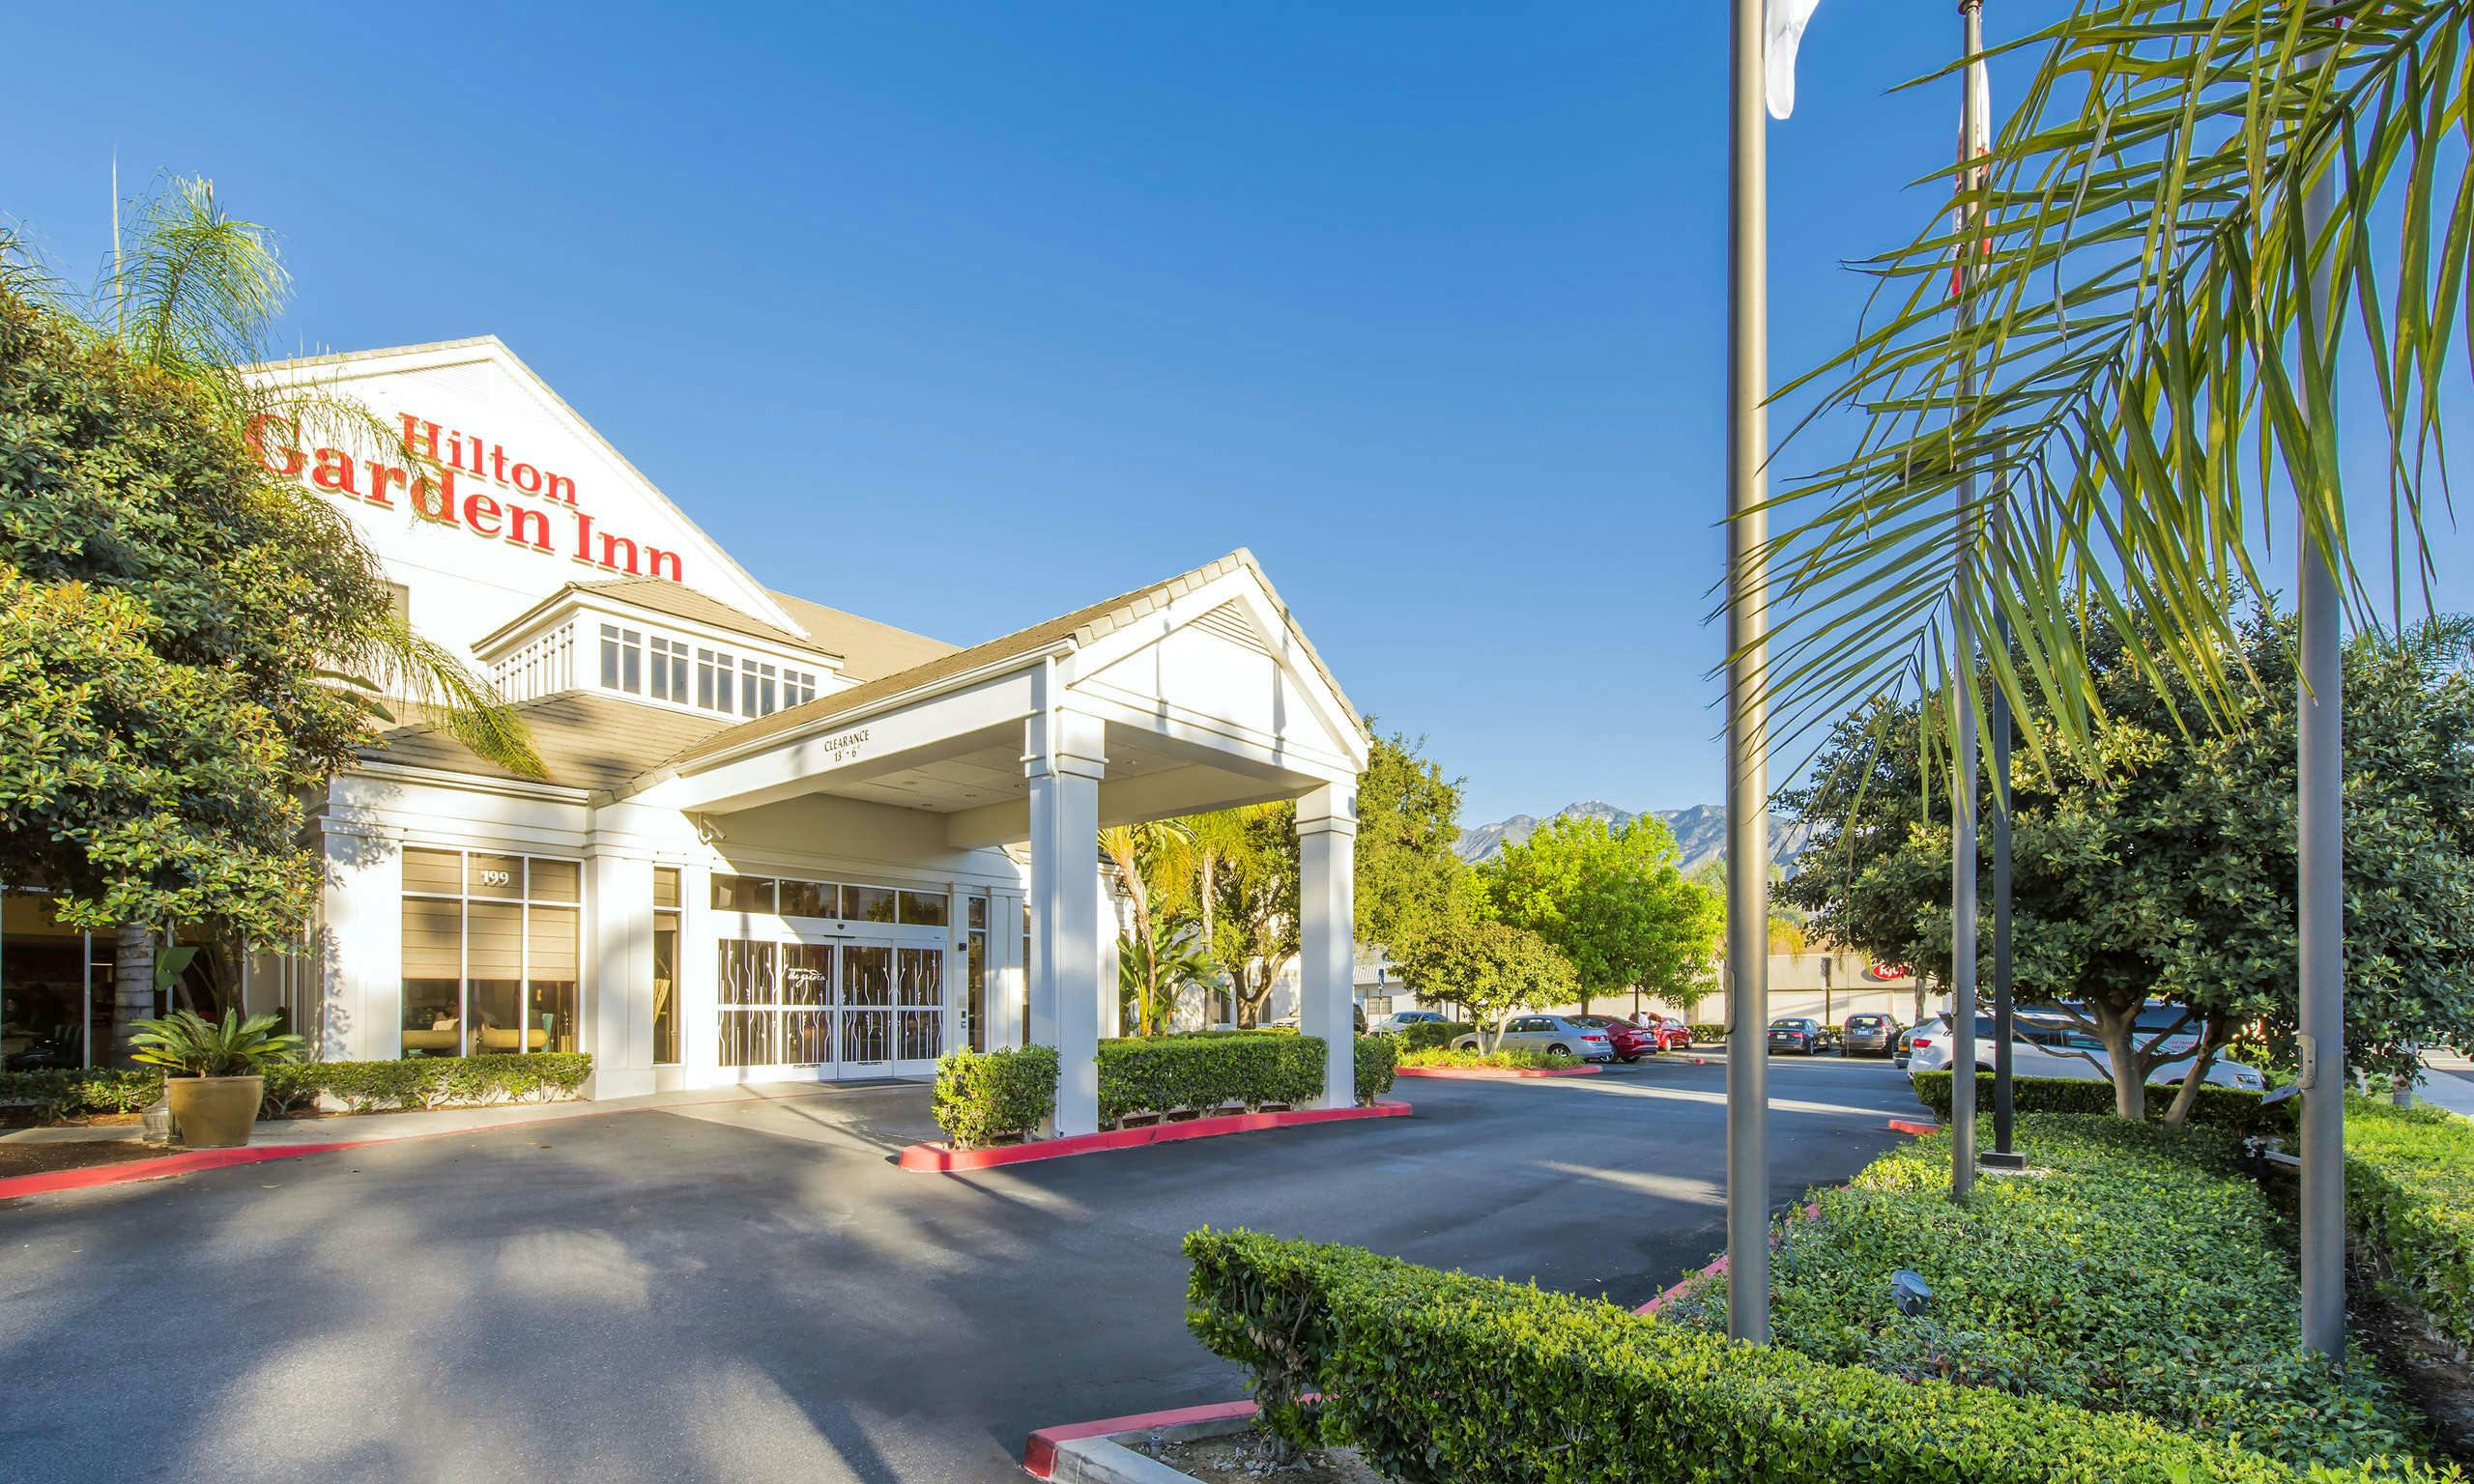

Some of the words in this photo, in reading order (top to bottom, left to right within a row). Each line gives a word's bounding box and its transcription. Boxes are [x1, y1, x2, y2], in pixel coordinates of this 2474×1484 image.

[398, 412, 580, 507] Hilton
[245, 413, 556, 553] Garden
[571, 511, 683, 583] Inn
[824, 728, 870, 752] CLEARANCE
[480, 870, 509, 885] 199
